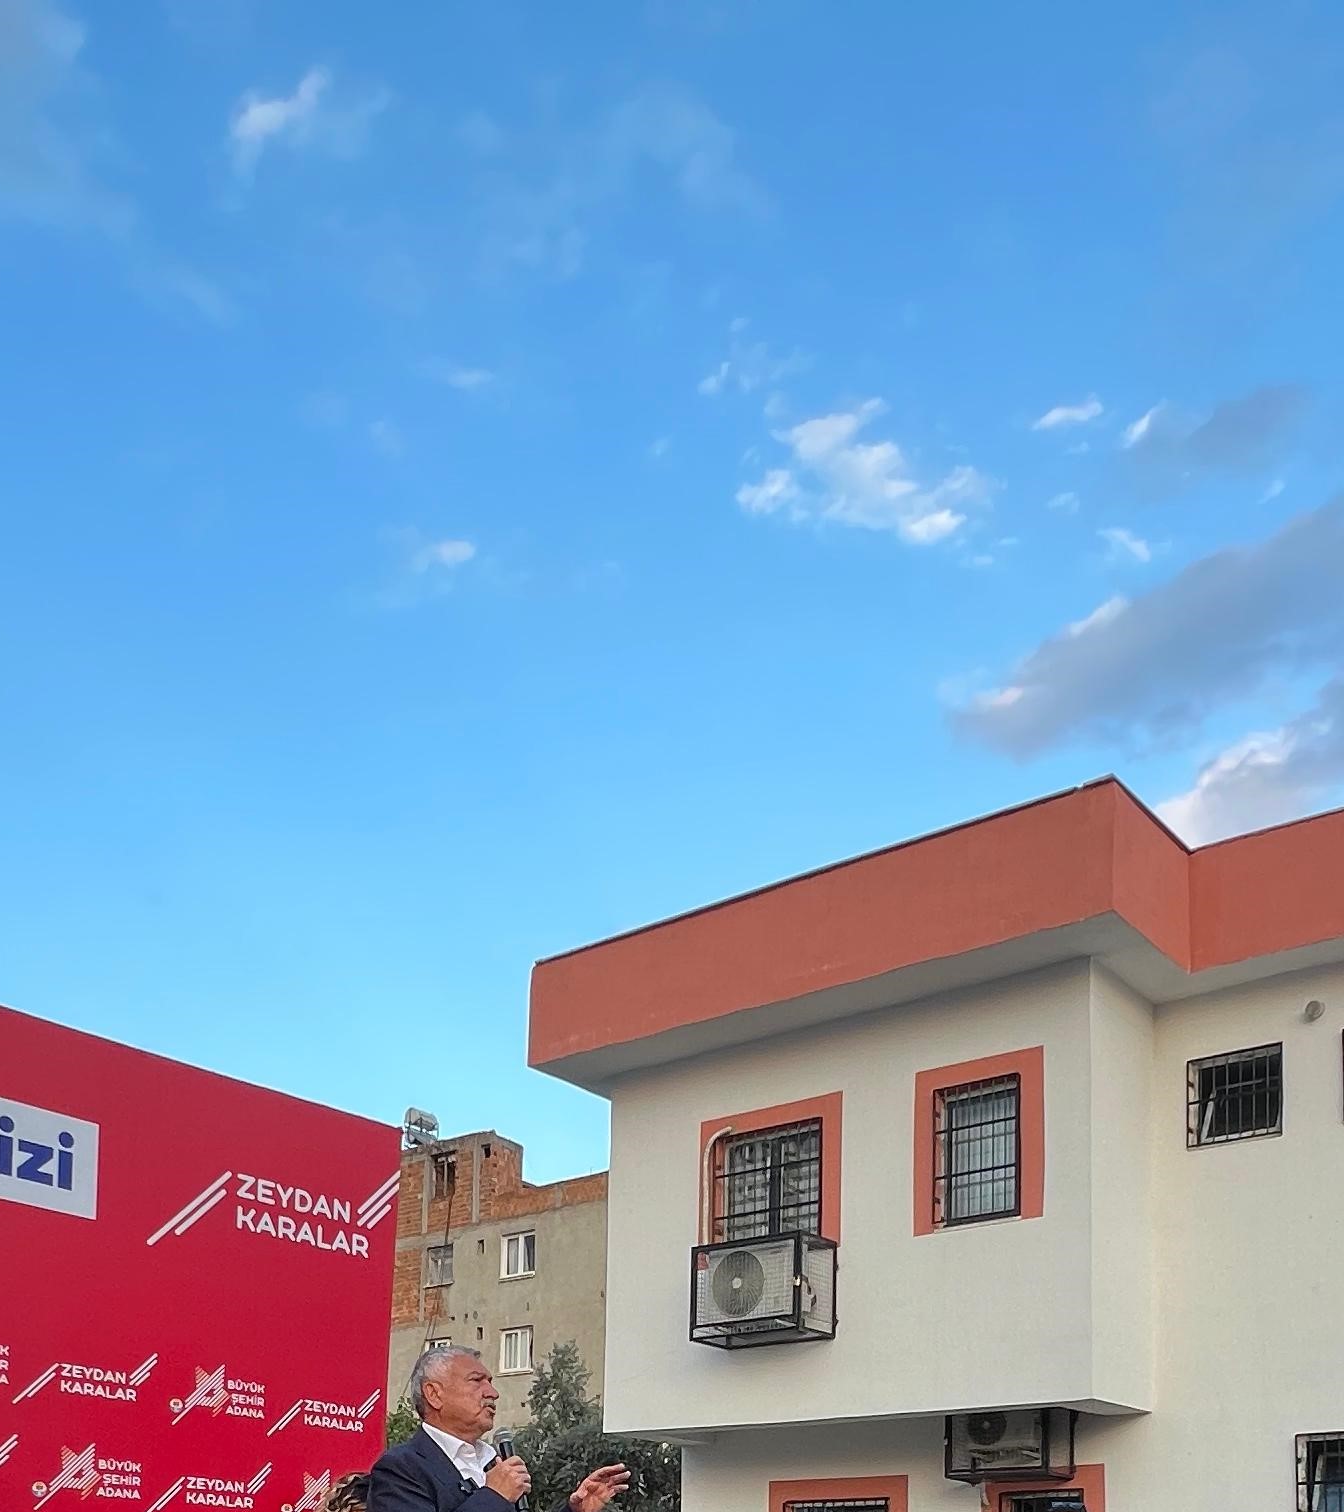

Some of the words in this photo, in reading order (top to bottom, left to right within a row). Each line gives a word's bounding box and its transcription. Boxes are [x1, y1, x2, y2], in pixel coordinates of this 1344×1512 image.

[236, 1172, 351, 1225] ZEYDAN
[236, 1206, 370, 1259] KARALAR
[60, 1363, 127, 1385] ZEYDAN
[60, 1380, 137, 1402] KARALAR
[227, 1379, 265, 1394] BÜYÜK
[230, 1393, 265, 1408] ŞEHİR
[304, 1399, 356, 1418] ZEYDAN
[225, 1405, 265, 1419] ADANA
[304, 1414, 364, 1432] KARALAR
[98, 1459, 141, 1473] BÜYÜK
[102, 1472, 141, 1487] ŞEHİR
[186, 1476, 244, 1494] ZEYDAN
[96, 1486, 141, 1500] ADANA
[186, 1492, 254, 1509] KARALAR
